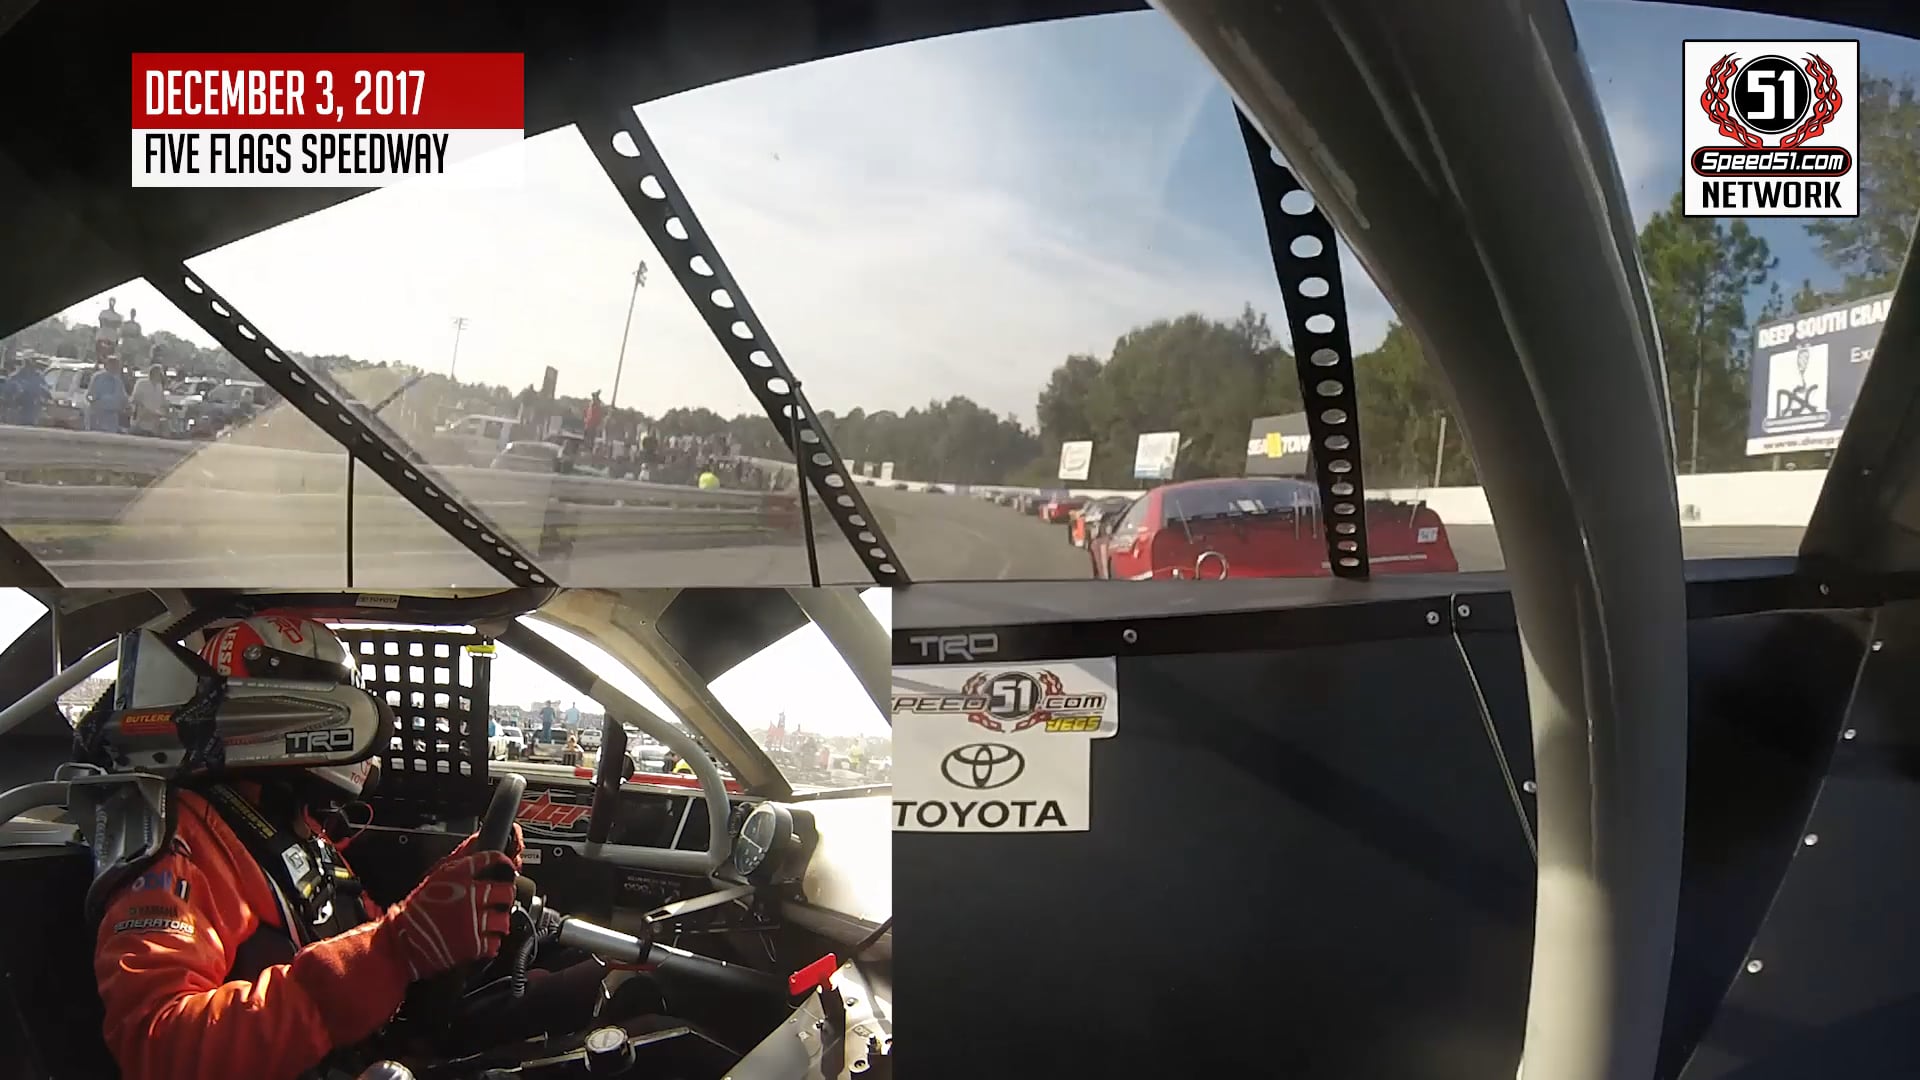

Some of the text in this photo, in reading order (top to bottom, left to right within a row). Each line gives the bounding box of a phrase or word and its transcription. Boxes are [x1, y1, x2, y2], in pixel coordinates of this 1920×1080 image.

[1758, 322, 1795, 349] DEEP
[1796, 309, 1848, 339] SOUTH
[1776, 384, 1818, 418] DSC
[1281, 434, 1311, 453] TOW
[910, 633, 998, 662] TRD
[1046, 716, 1102, 733] JEGS
[286, 729, 353, 752] TRD
[893, 800, 1068, 828] TOYOTA
